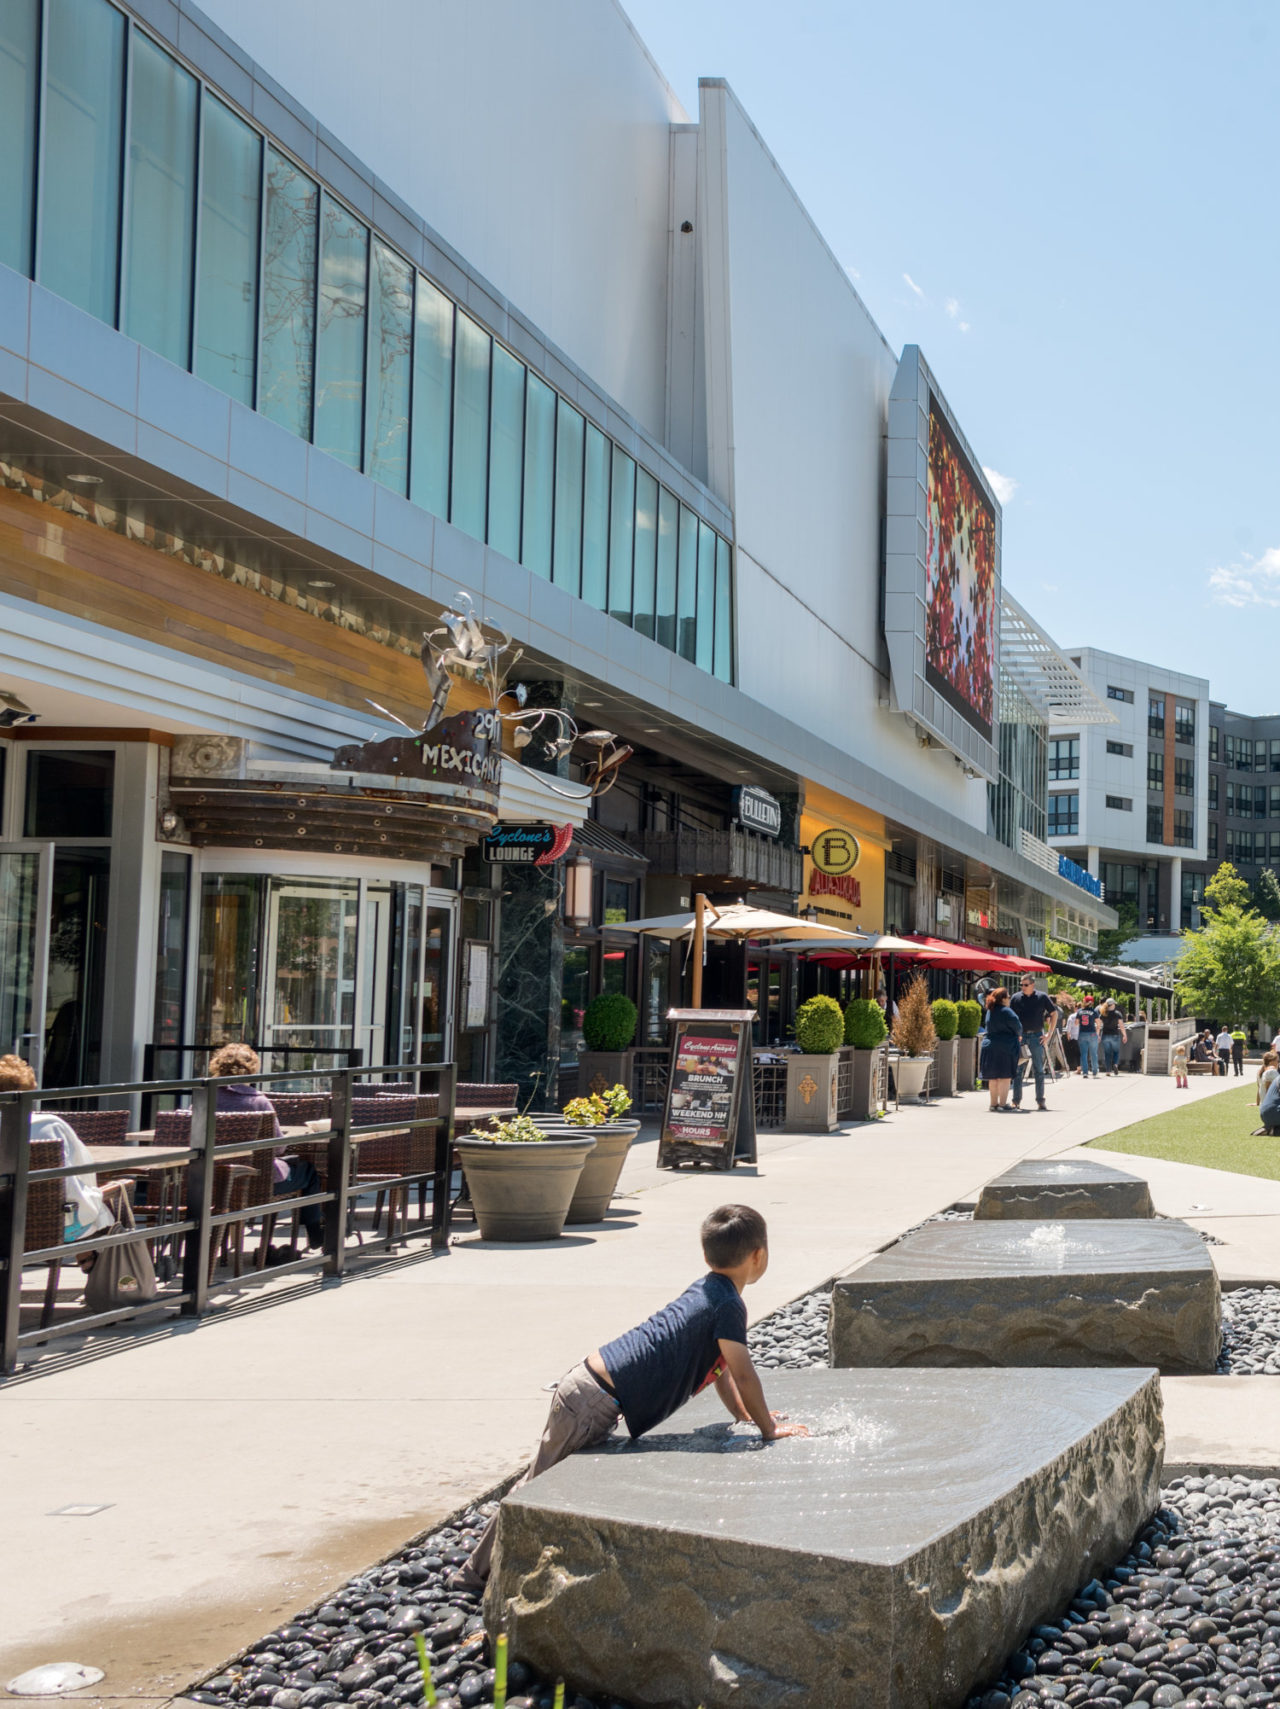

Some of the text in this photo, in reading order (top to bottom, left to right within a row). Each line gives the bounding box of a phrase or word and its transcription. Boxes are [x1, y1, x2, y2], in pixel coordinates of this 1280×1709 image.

[744, 795, 778, 828] BULLETIN
[486, 826, 552, 846] Cyclone's
[489, 846, 535, 861] LOUNGE
[688, 1074, 723, 1083] BRUNCH
[672, 1109, 714, 1119] WEEKEND
[682, 1127, 711, 1135] HOURS
